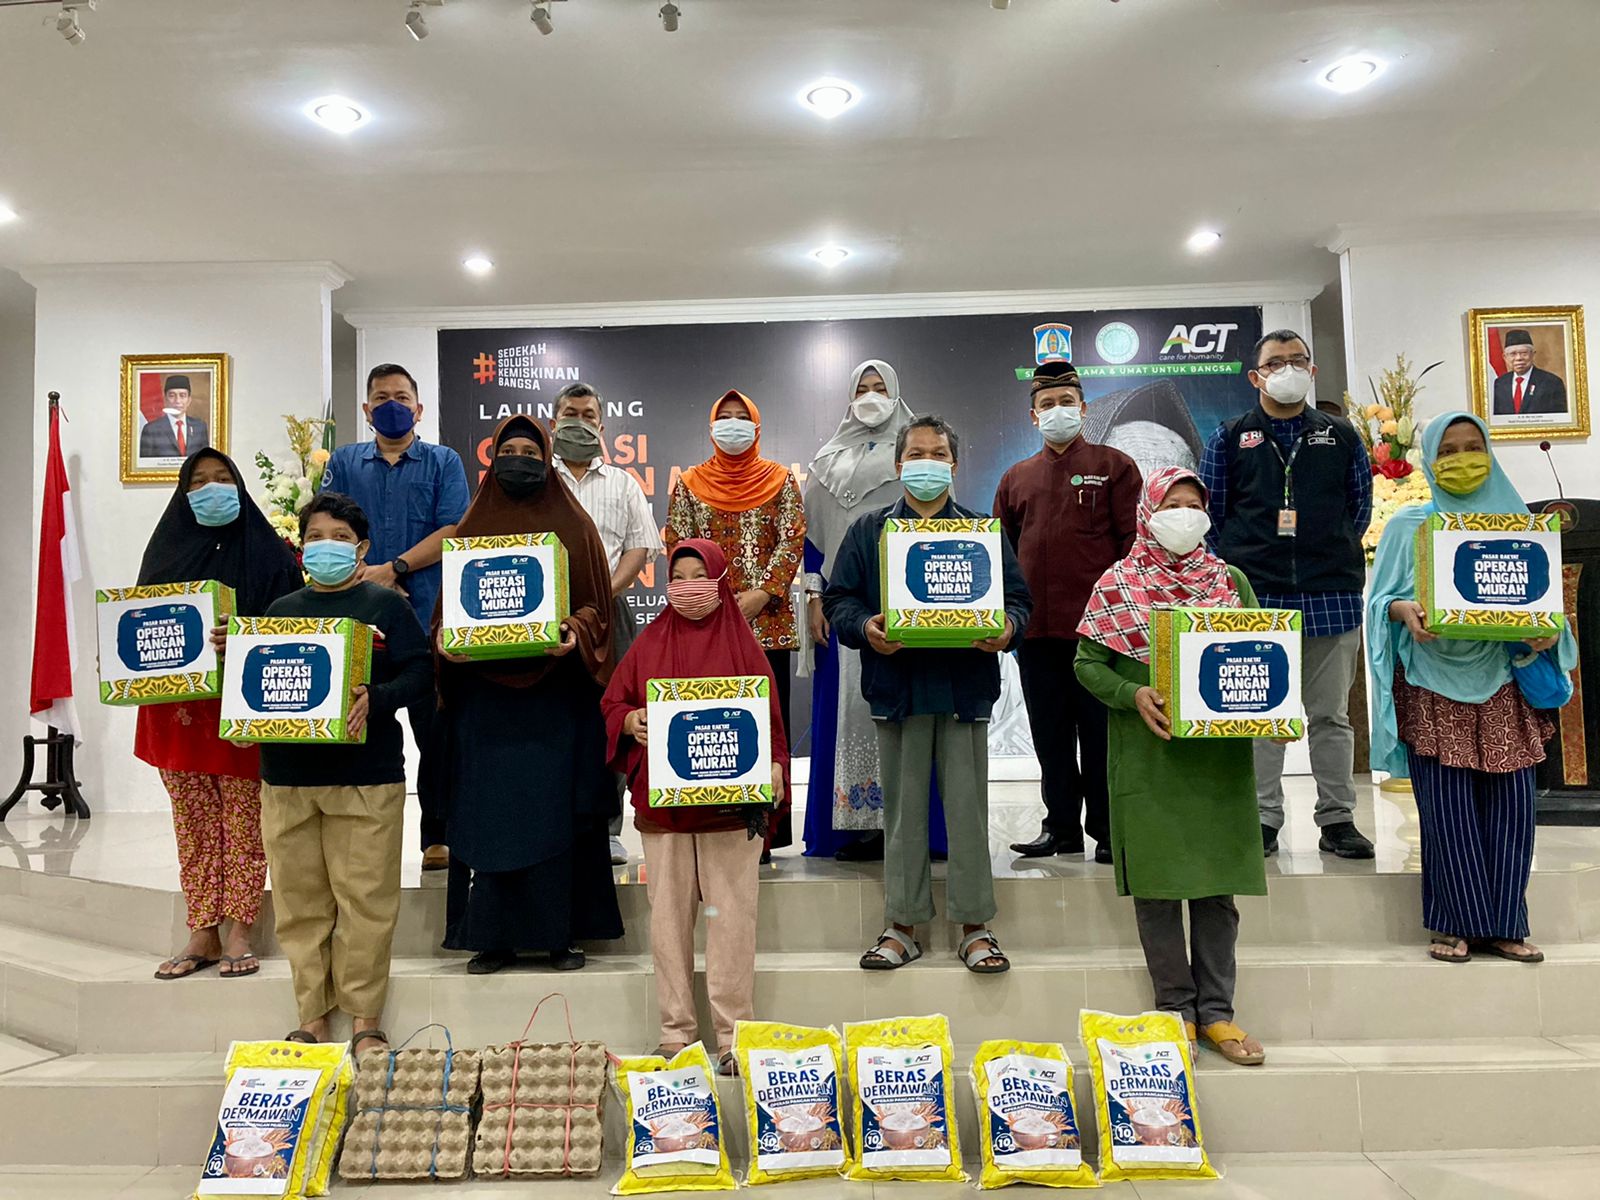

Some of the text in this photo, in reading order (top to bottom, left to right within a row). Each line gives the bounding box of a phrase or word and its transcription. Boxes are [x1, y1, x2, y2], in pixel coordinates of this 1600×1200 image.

[1160, 323, 1238, 354] ACT
[498, 342, 546, 358] SEDEKAH
[1176, 352, 1186, 360] for
[1188, 352, 1224, 361] humanity
[498, 356, 534, 368] SOLUSI
[498, 367, 580, 380] KEMISKINAN
[1119, 366, 1148, 374] UMAT
[1190, 364, 1232, 373] BANGSA
[498, 378, 540, 390] BANGSA
[480, 400, 644, 420] LAUNNG
[924, 561, 972, 572] OPERASI
[1474, 561, 1528, 572] OPERASI
[479, 575, 525, 588] OPERASI
[924, 572, 973, 583] PANGAN
[1474, 572, 1528, 584] PANGAN
[479, 586, 526, 600] PANGAN
[927, 583, 971, 594] MURAH
[1478, 584, 1526, 595] MURAH
[482, 598, 524, 610] MURAH
[137, 624, 184, 640] OPERASI
[137, 636, 186, 651] PANGAN
[140, 647, 183, 662] MURAH
[262, 666, 312, 678] OPERASI
[1219, 665, 1269, 677] OPERASI
[261, 678, 312, 690] PANGAN
[1219, 677, 1270, 690] PANGAN
[264, 690, 308, 702] MURAH
[1222, 690, 1267, 702] MURAH
[688, 732, 738, 745] OPERASI
[688, 744, 739, 758] PANGAN
[691, 757, 737, 770] MURAH
[875, 1069, 926, 1083] BERAS
[1120, 1062, 1171, 1078] BERAS
[768, 1070, 820, 1086] BERAS
[758, 1082, 834, 1102] DERMAWAN
[863, 1082, 940, 1098] DERMAWAN
[1002, 1078, 1052, 1094] BERAS
[1111, 1077, 1185, 1094] DERMAWAN
[238, 1092, 294, 1107] BERAS
[992, 1092, 1067, 1107] DERMAWAN
[222, 1108, 301, 1122] DERMAWAN
